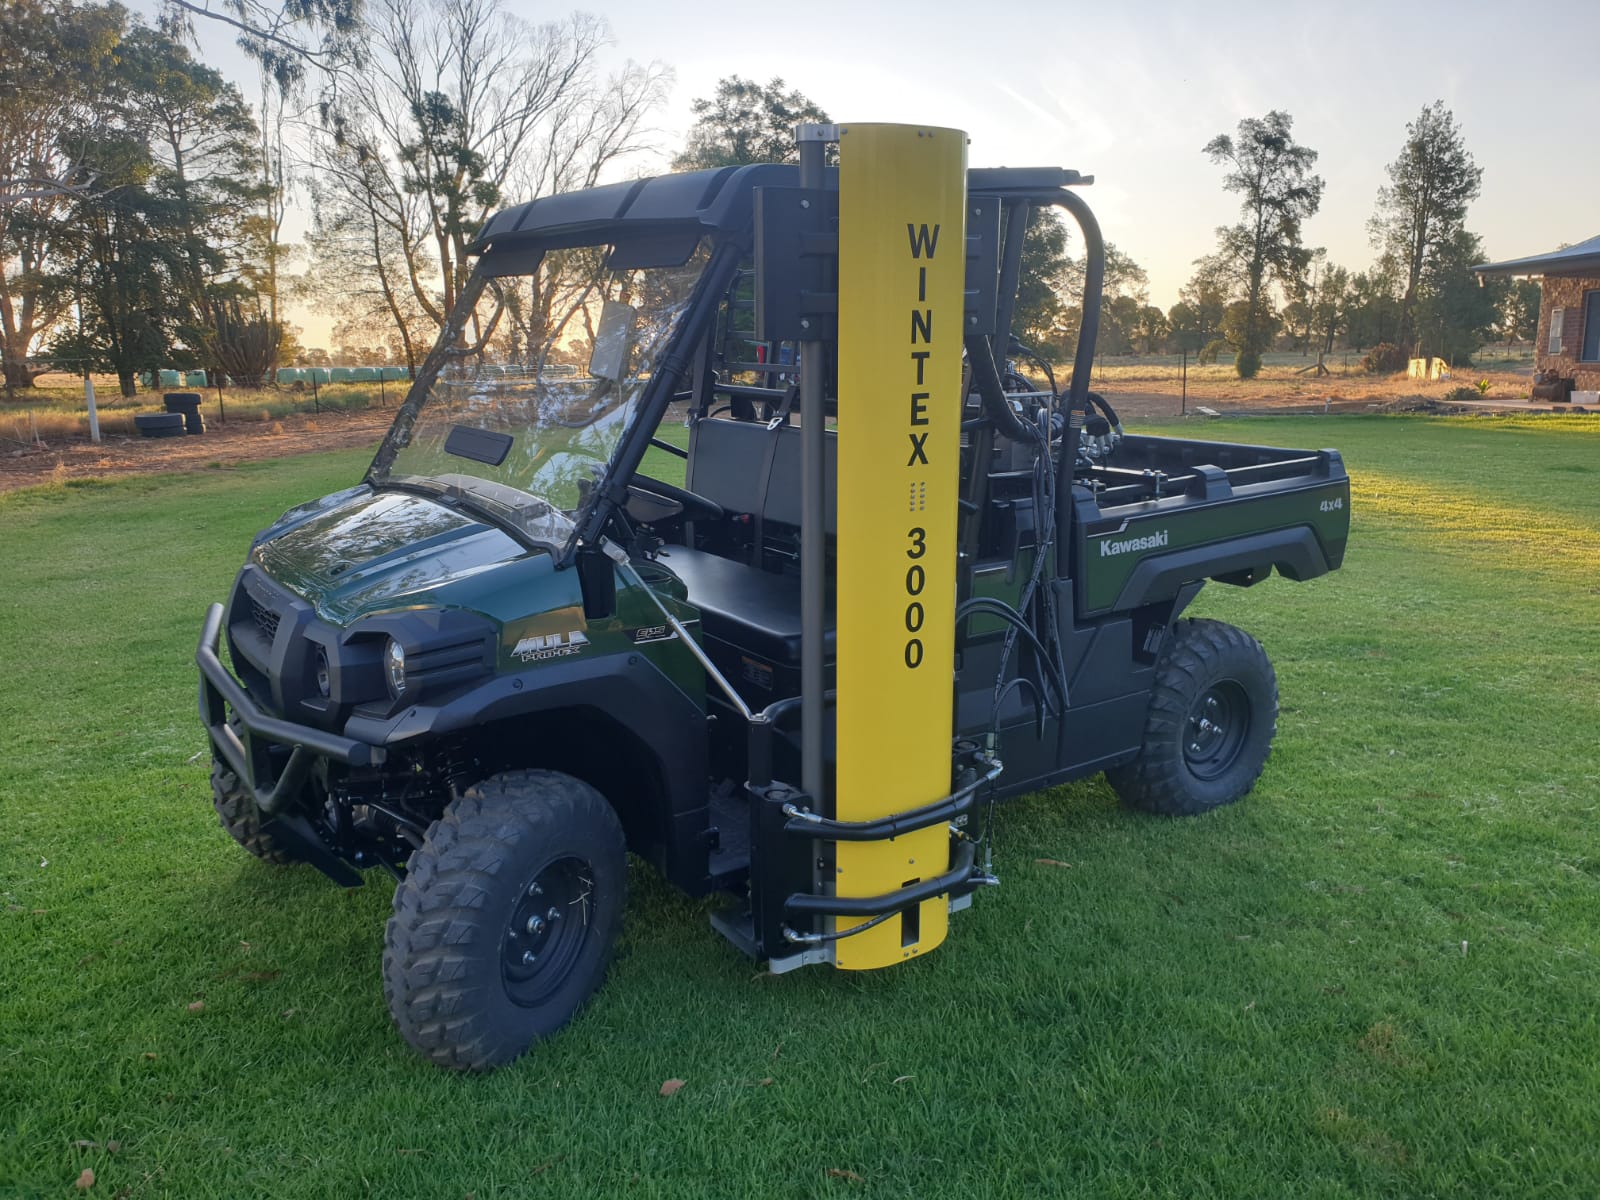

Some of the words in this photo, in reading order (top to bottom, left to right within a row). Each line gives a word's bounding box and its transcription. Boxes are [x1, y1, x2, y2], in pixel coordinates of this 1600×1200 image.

[907, 223, 940, 467] WINTEX
[1099, 529, 1169, 557] Kawasaki
[1319, 497, 1343, 513] 4x4
[904, 527, 927, 669] 3000
